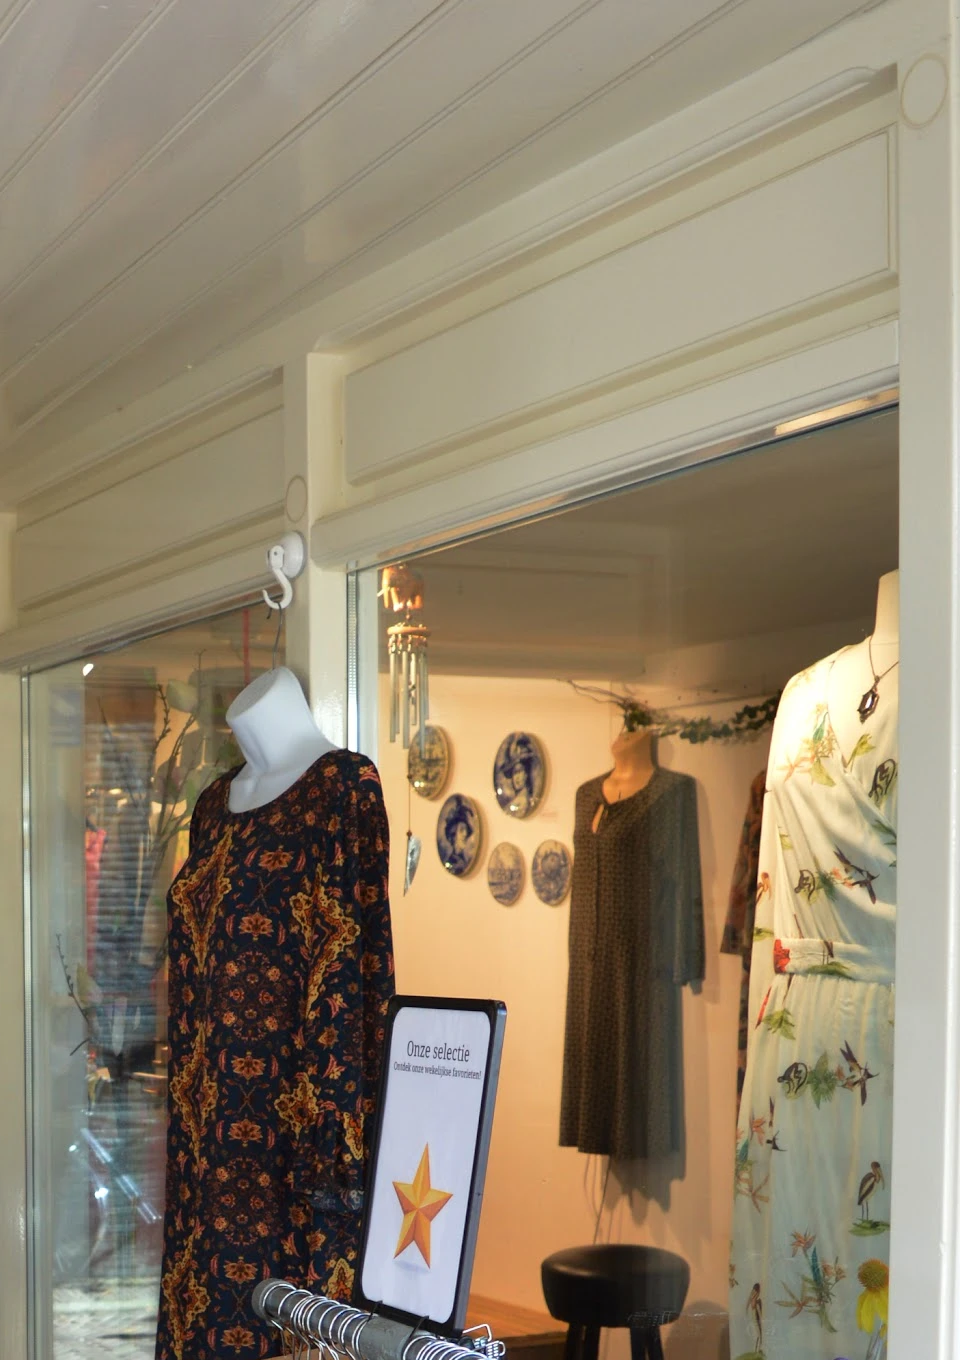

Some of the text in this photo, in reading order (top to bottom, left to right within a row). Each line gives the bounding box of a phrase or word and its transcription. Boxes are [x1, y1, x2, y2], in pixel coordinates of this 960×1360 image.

[407, 1040, 470, 1062] Onze selectie
[393, 1061, 411, 1072] Ontdek
[412, 1064, 424, 1074] onze
